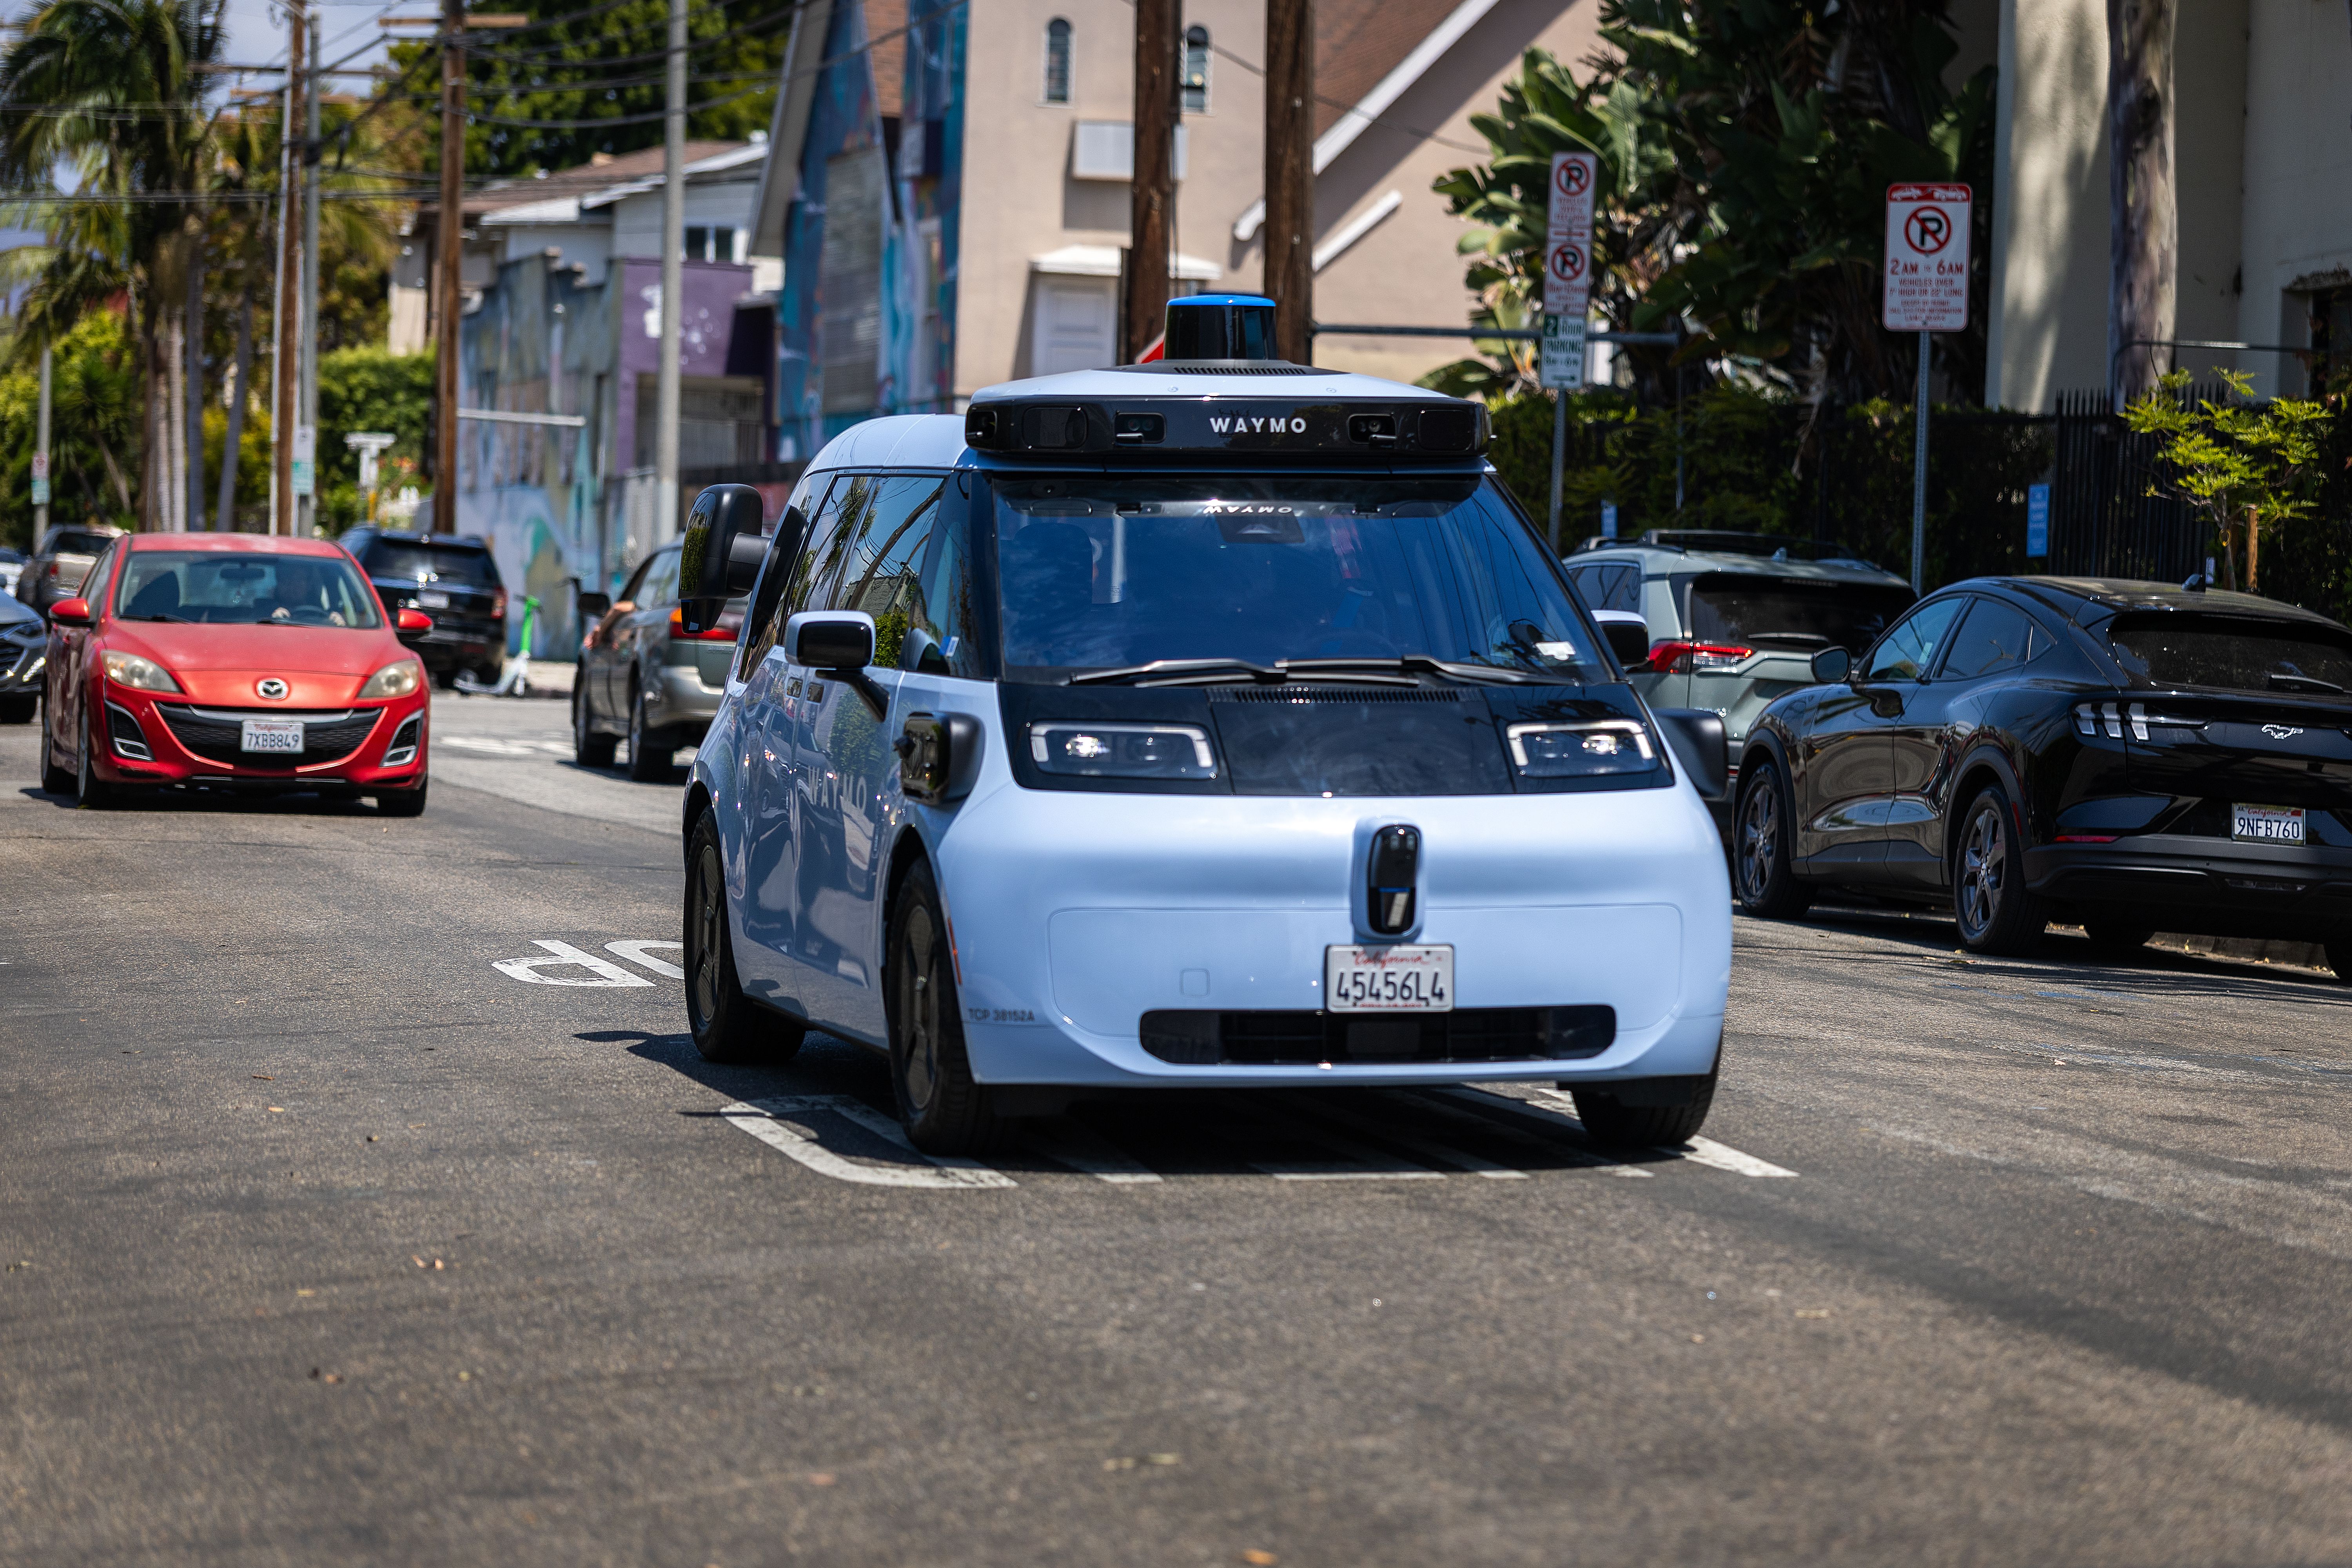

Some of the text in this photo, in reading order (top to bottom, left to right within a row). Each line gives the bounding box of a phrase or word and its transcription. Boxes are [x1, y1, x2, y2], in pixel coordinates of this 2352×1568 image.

[1890, 258, 1918, 276] 2AM
[1936, 258, 1964, 276] 6AM
[1898, 277, 1955, 287] VEHICLES OVER
[1944, 289, 1964, 297] LONG
[1546, 318, 1556, 335] 2
[1210, 417, 1307, 433] WAYMO
[247, 733, 299, 749] 7XBB849
[808, 766, 867, 814] WAYMO
[2247, 808, 2291, 818] California
[2238, 817, 2300, 838] 9NFB760
[1354, 949, 1430, 969] California
[1336, 971, 1445, 1001] 45456L4
